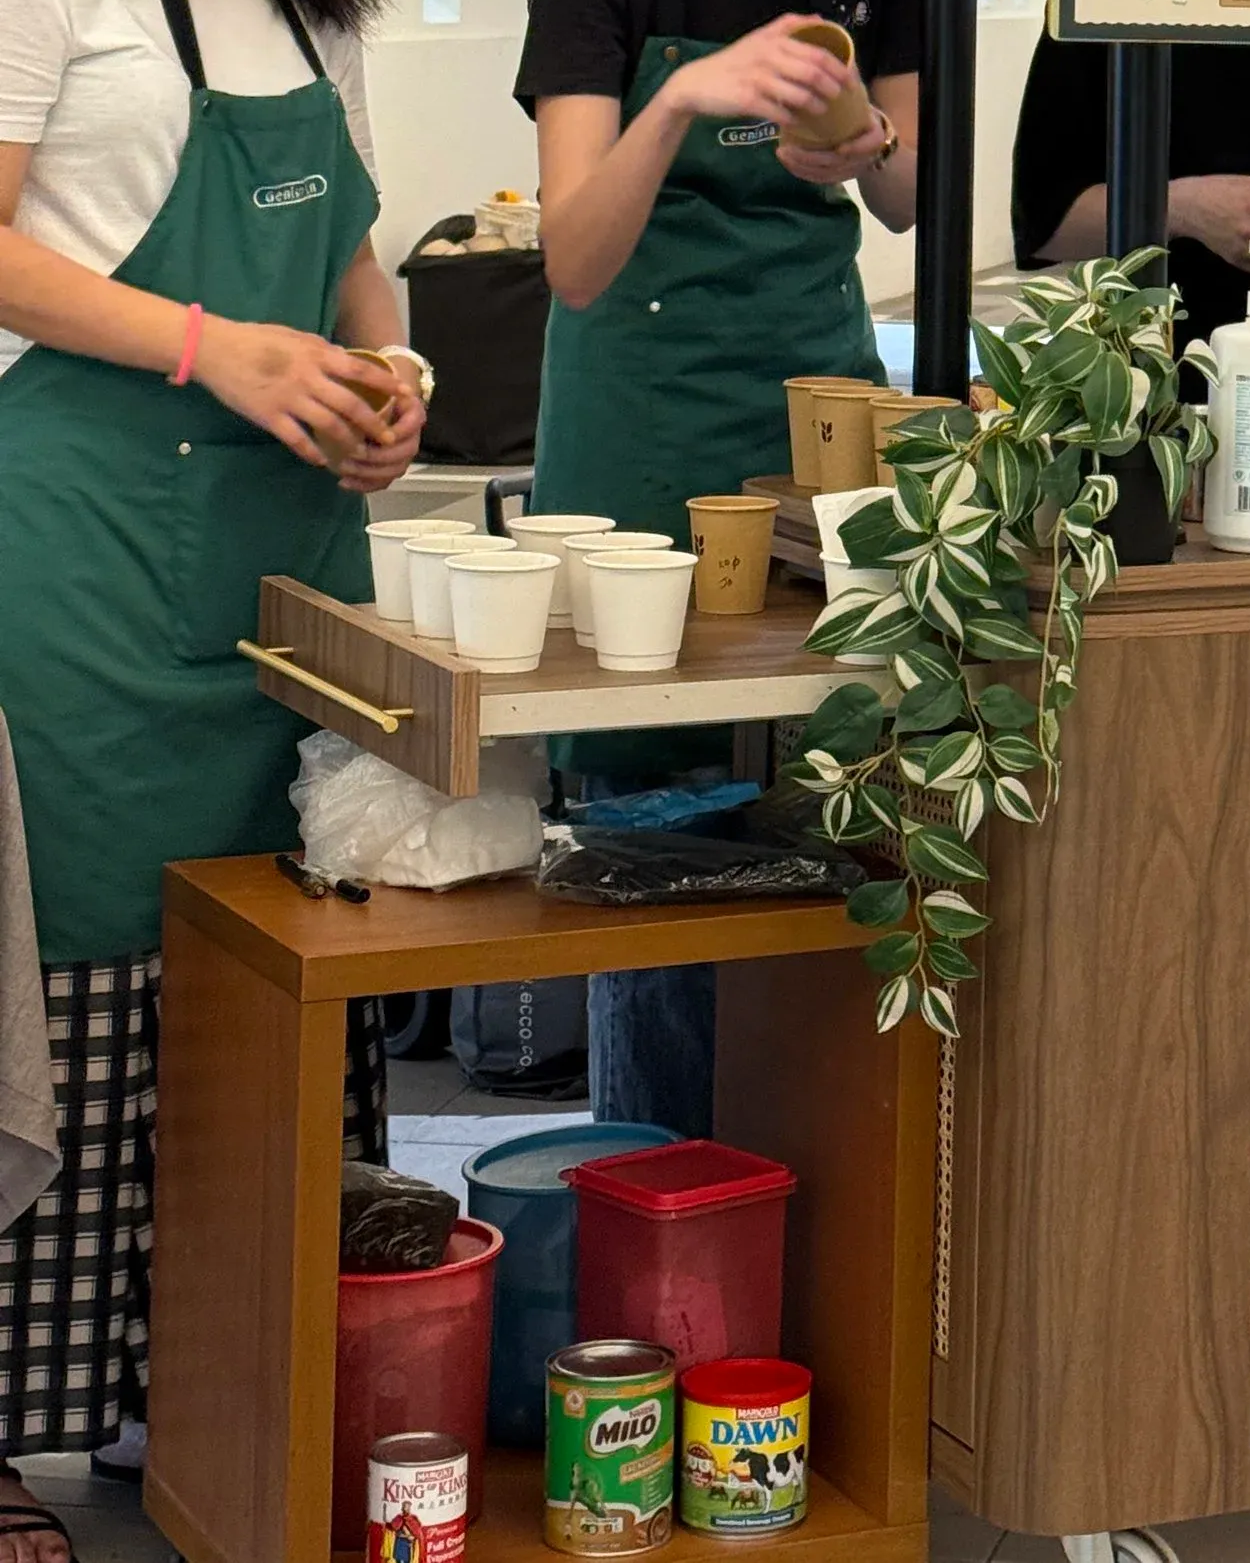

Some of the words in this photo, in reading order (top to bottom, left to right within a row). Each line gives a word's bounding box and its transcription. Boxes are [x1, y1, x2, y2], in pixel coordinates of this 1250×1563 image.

[728, 125, 776, 142] Genista
[594, 1413, 657, 1446] MILO
[710, 1412, 801, 1445] DAWN
[383, 1478, 425, 1503] KING
[438, 1473, 467, 1496] KING
